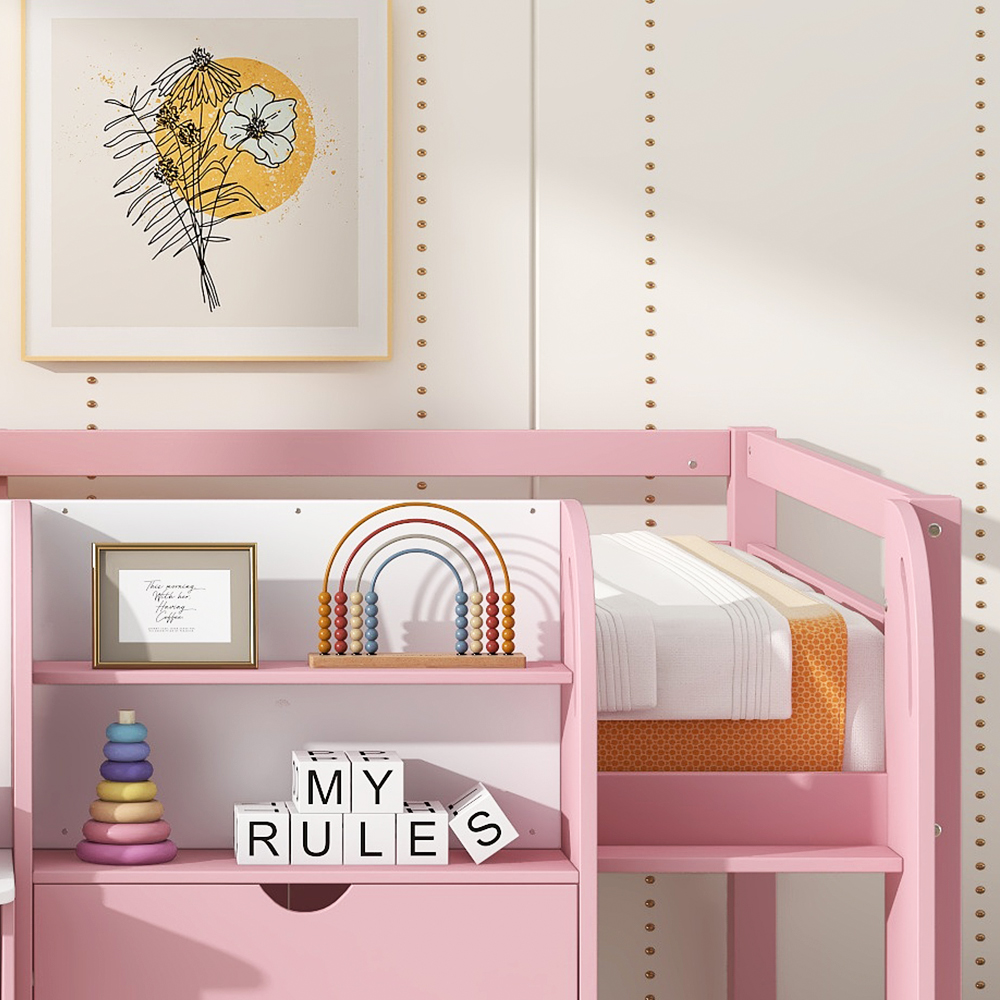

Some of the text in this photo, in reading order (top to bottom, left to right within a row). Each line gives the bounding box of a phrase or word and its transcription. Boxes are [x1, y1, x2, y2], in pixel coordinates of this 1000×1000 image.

[144, 579, 163, 591] This
[152, 589, 174, 602] With
[155, 600, 197, 614] Having
[308, 770, 393, 805] MY
[249, 810, 502, 857] RULES
